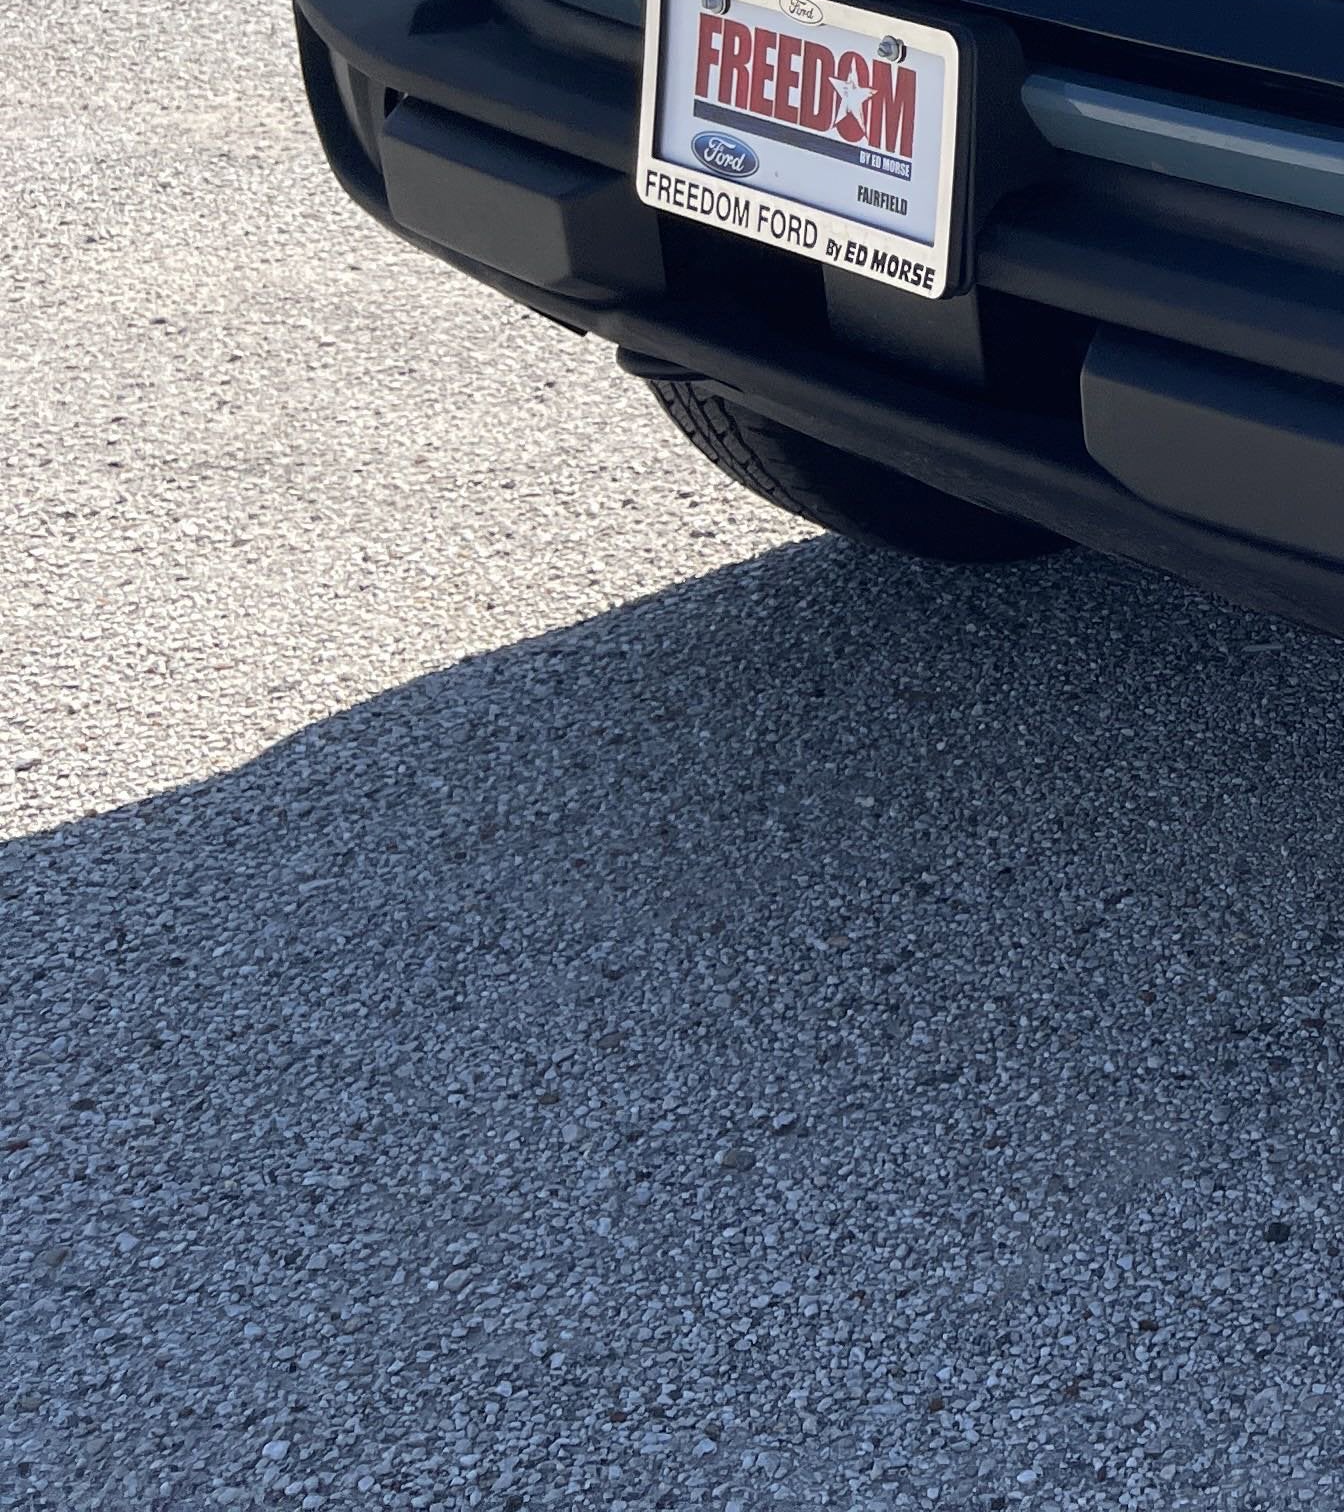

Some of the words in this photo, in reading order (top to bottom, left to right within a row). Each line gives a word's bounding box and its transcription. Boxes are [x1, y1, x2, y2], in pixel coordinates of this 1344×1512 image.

[695, 13, 916, 157] FREEDOM
[703, 136, 746, 172] Ford
[859, 150, 871, 164] BY
[871, 154, 882, 169] ED
[882, 157, 910, 178] MORSE
[857, 185, 908, 216] FAIRFIELD
[645, 169, 751, 229] FREEDOM
[757, 203, 818, 249] FORD
[825, 238, 842, 261] By
[844, 240, 868, 267] ED
[870, 248, 936, 291] MORSE
